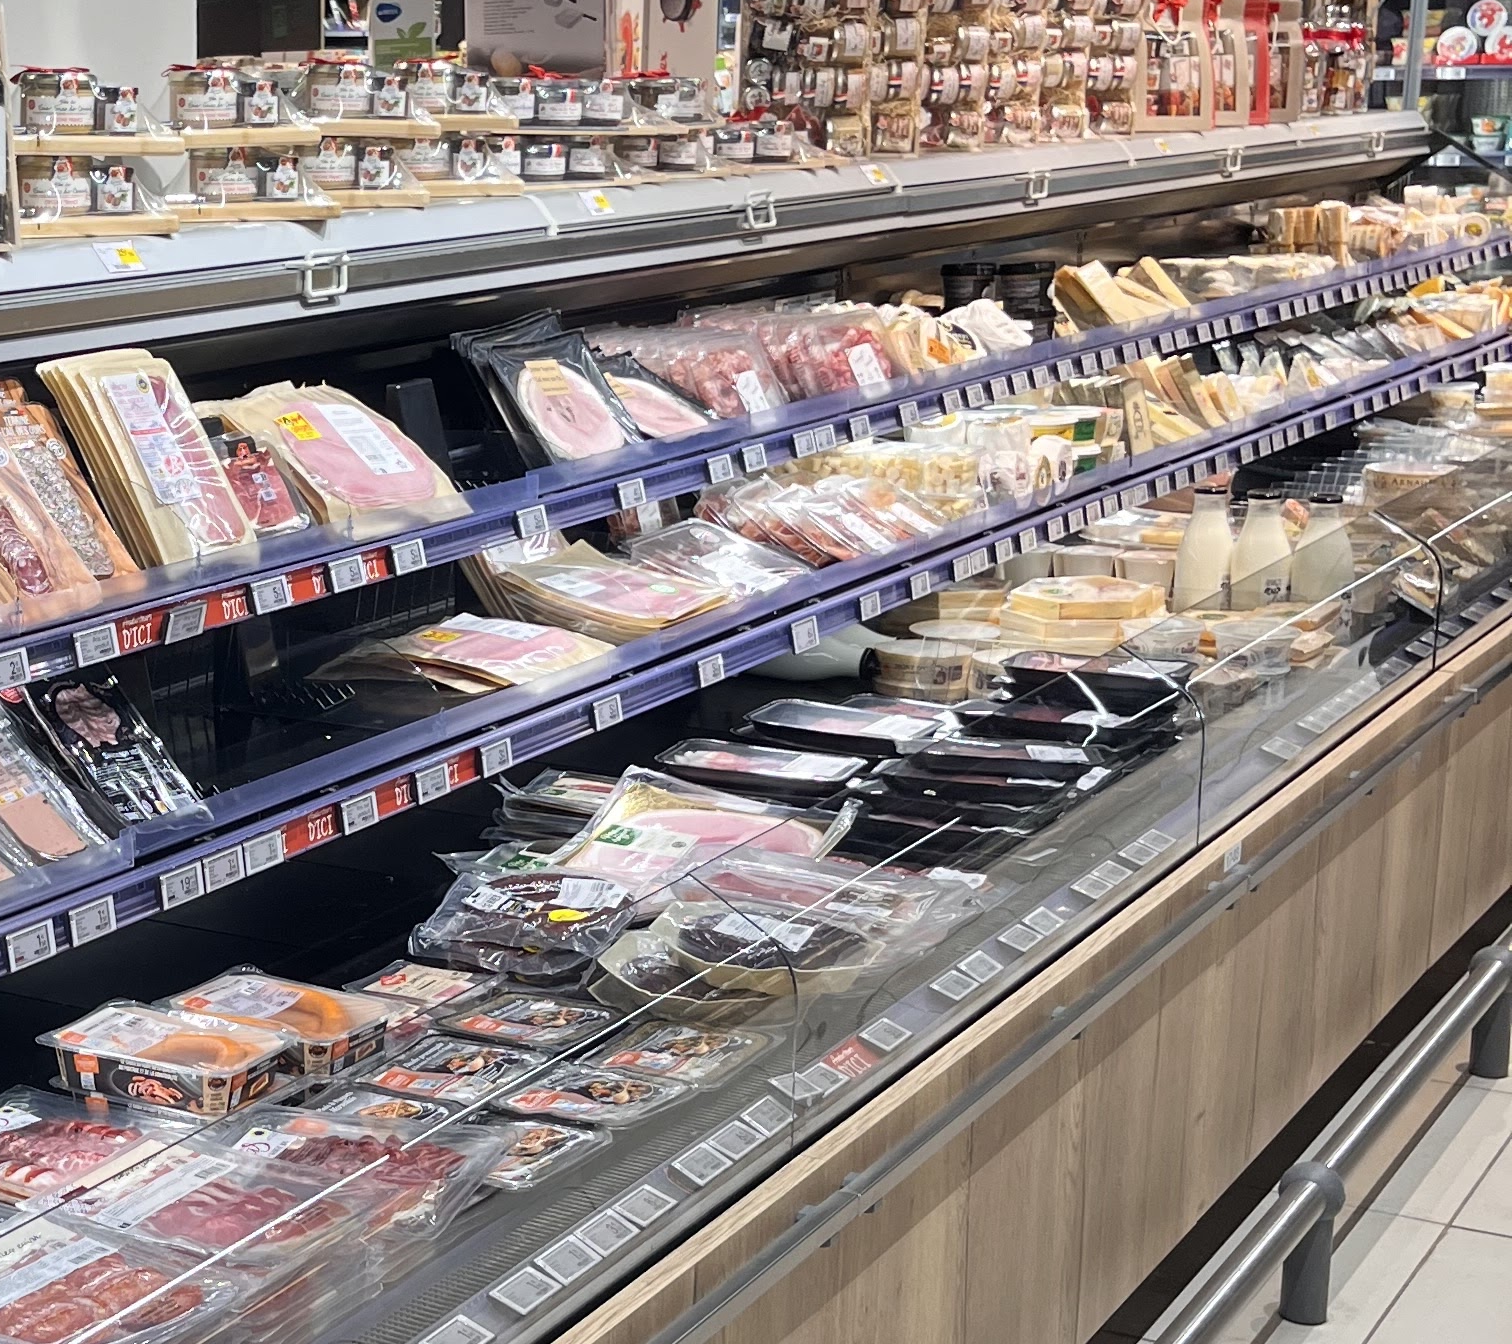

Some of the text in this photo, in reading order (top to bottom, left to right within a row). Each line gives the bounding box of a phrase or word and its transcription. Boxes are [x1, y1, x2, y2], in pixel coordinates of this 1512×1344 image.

[221, 596, 249, 620] D'ICI
[122, 624, 153, 650] D'ICI
[308, 814, 334, 842] D'ICI
